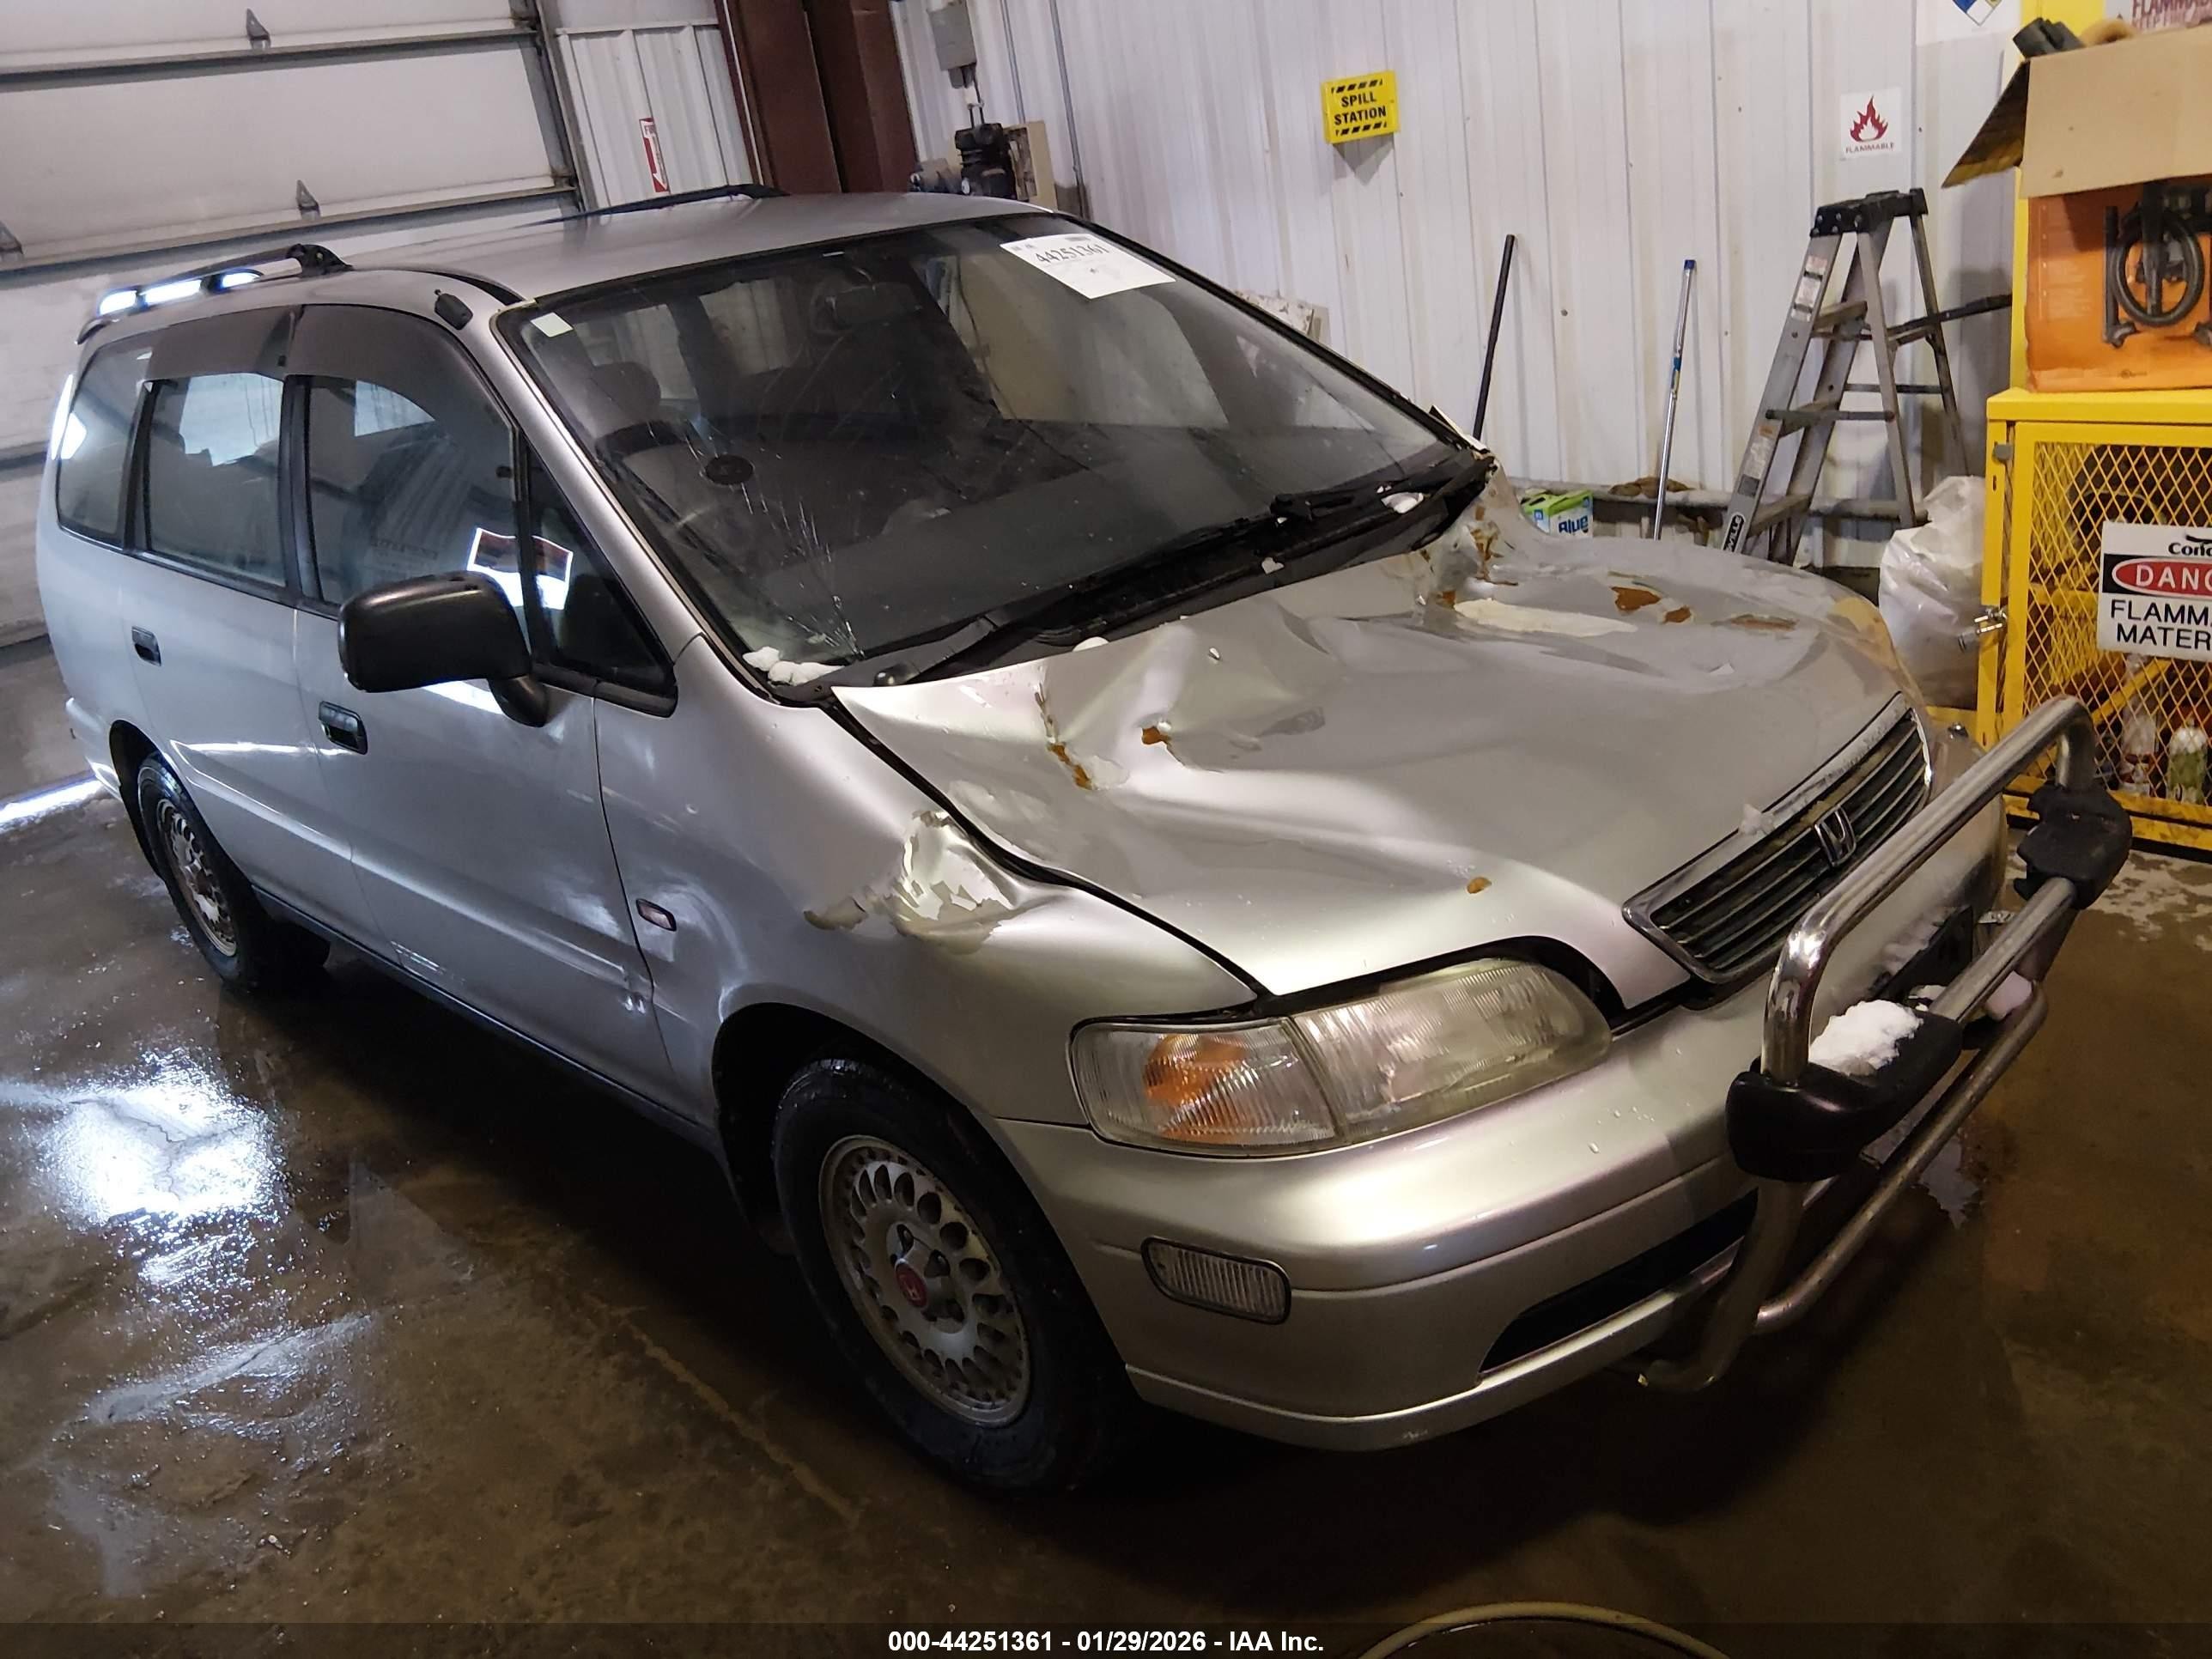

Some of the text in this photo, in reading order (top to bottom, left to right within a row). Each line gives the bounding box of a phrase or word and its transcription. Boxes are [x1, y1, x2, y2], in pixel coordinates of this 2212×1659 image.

[1340, 91, 1377, 107] SPILL
[1334, 106, 1387, 125] STATION
[1844, 142, 1895, 154] FLAMMABLE
[1035, 243, 1110, 264] 44251361
[2111, 599, 2212, 627] FLAMM
[2117, 623, 2211, 651] MATER
